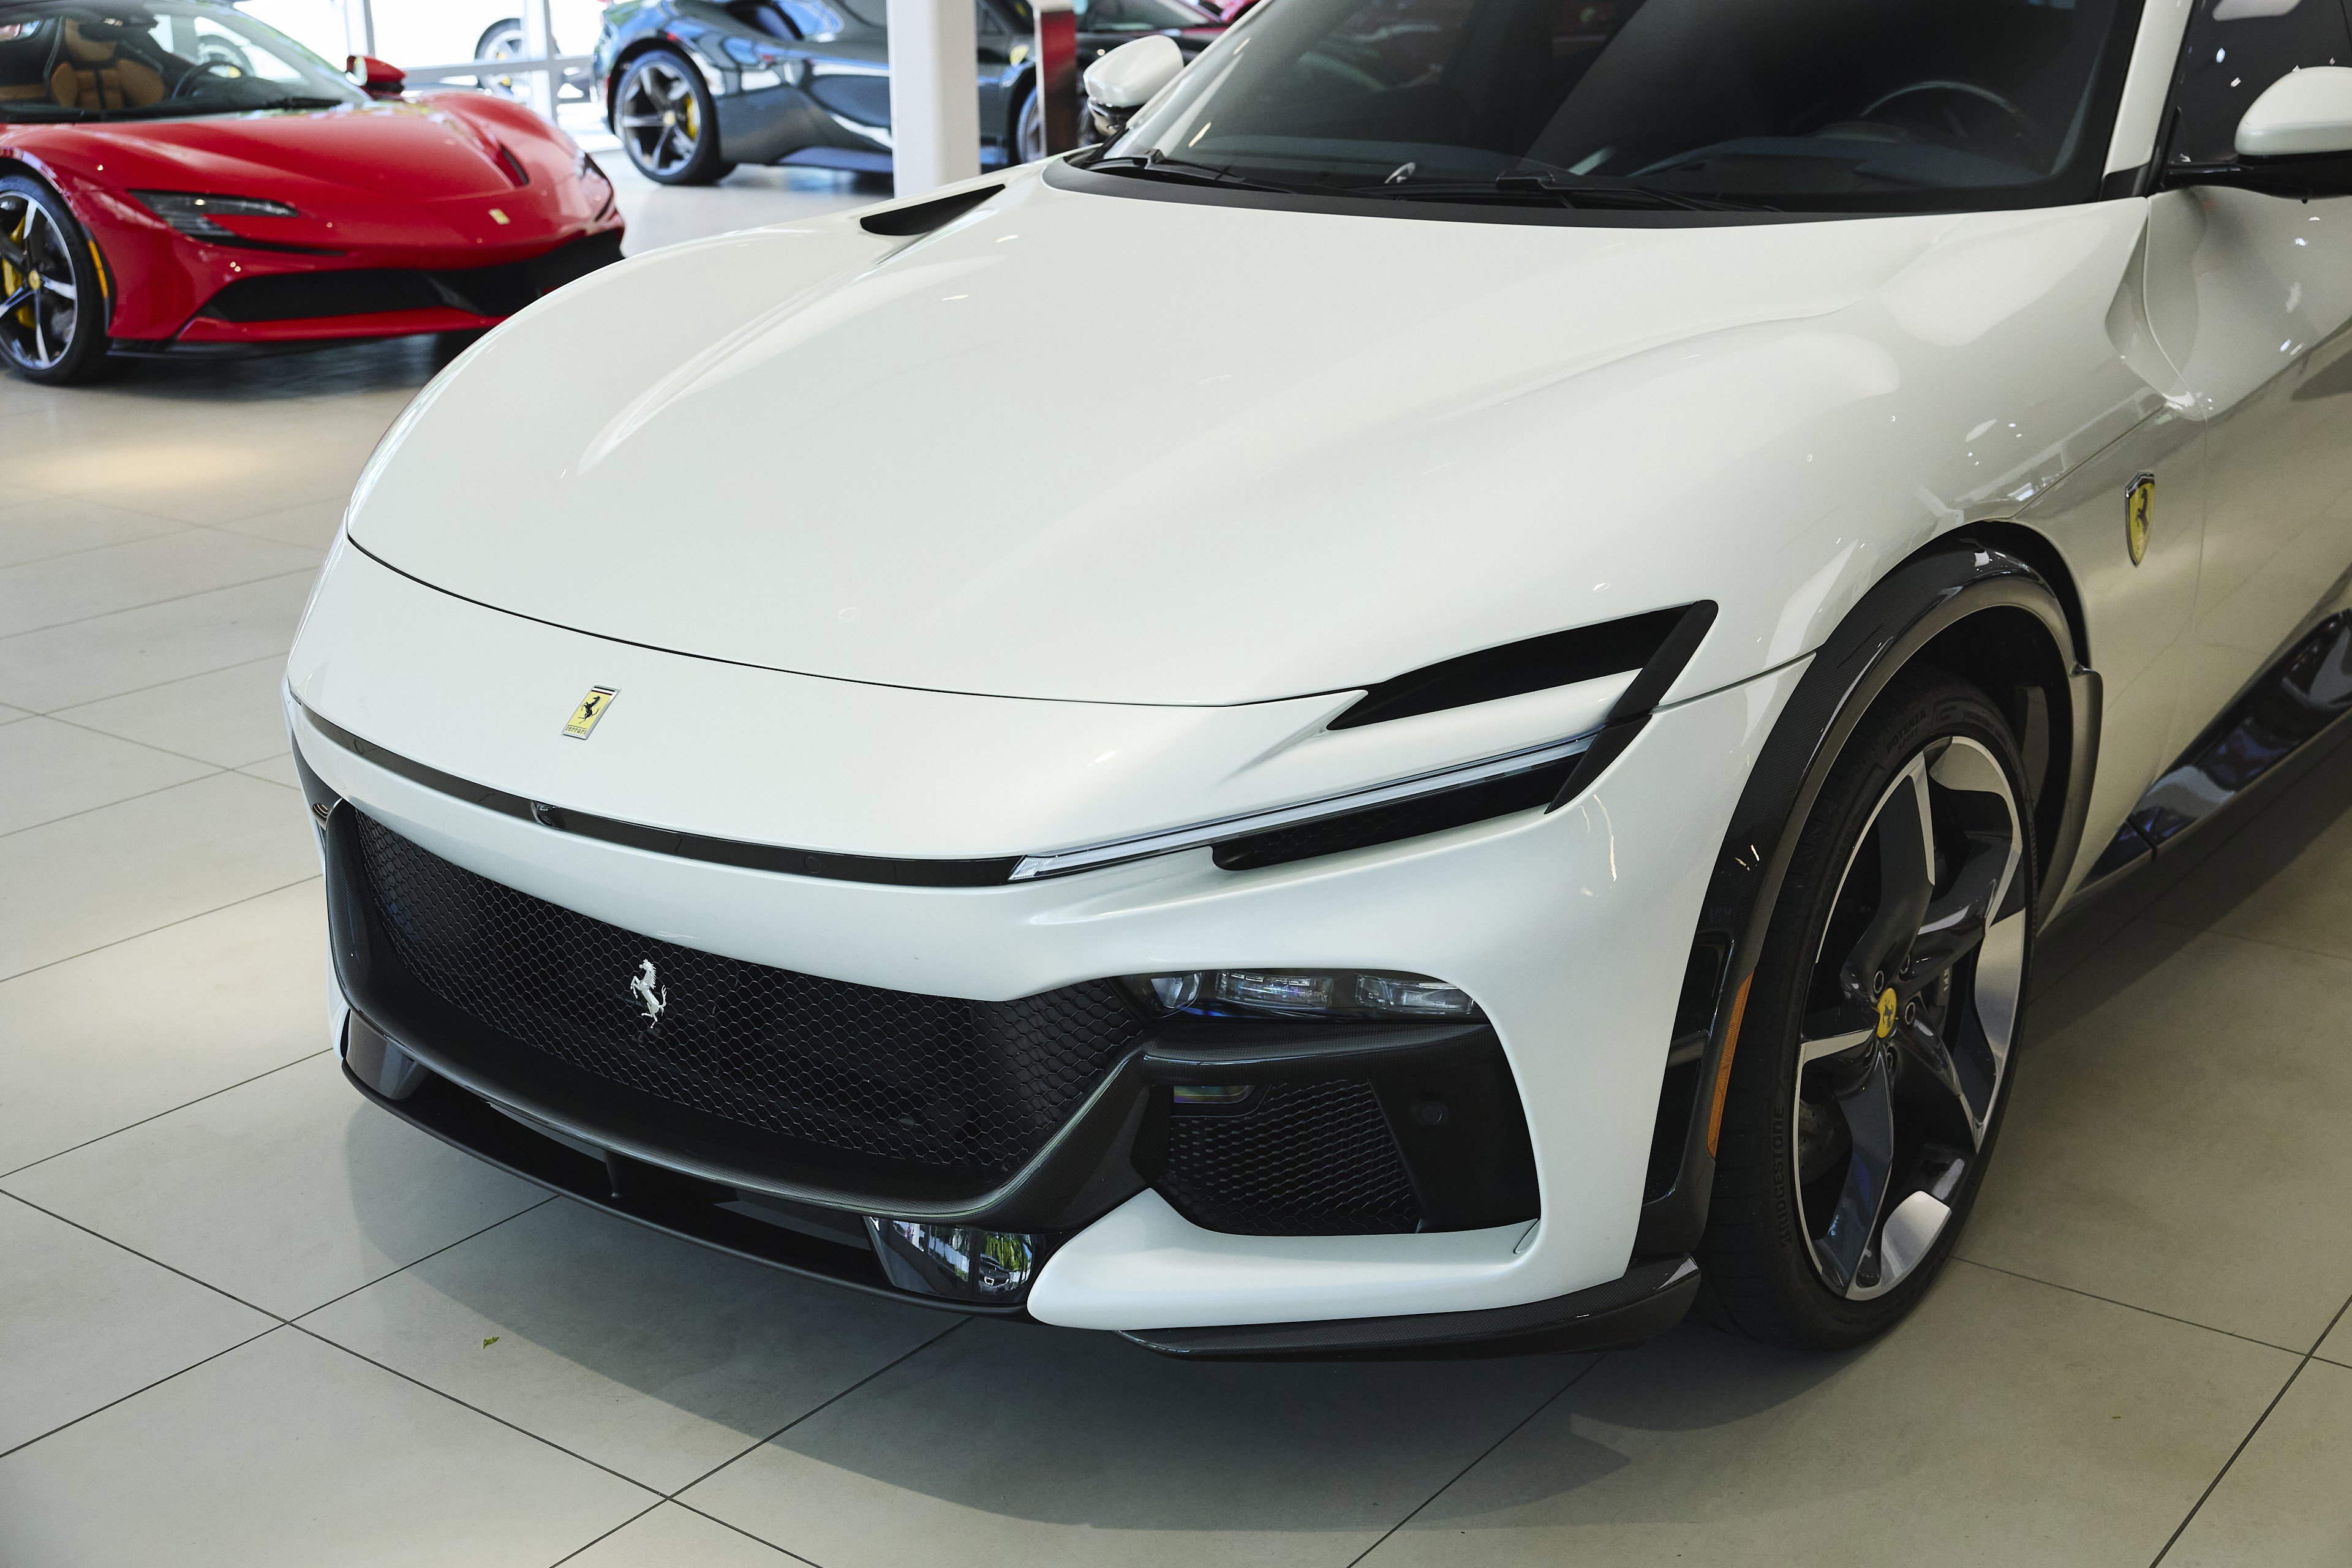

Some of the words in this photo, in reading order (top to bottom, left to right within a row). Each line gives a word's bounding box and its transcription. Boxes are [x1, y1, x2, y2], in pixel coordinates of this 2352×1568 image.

[565, 725, 587, 735] Ferrari
[1887, 710, 1926, 754] POTENZA
[1773, 1106, 1792, 1248] BRIDGESTONE
